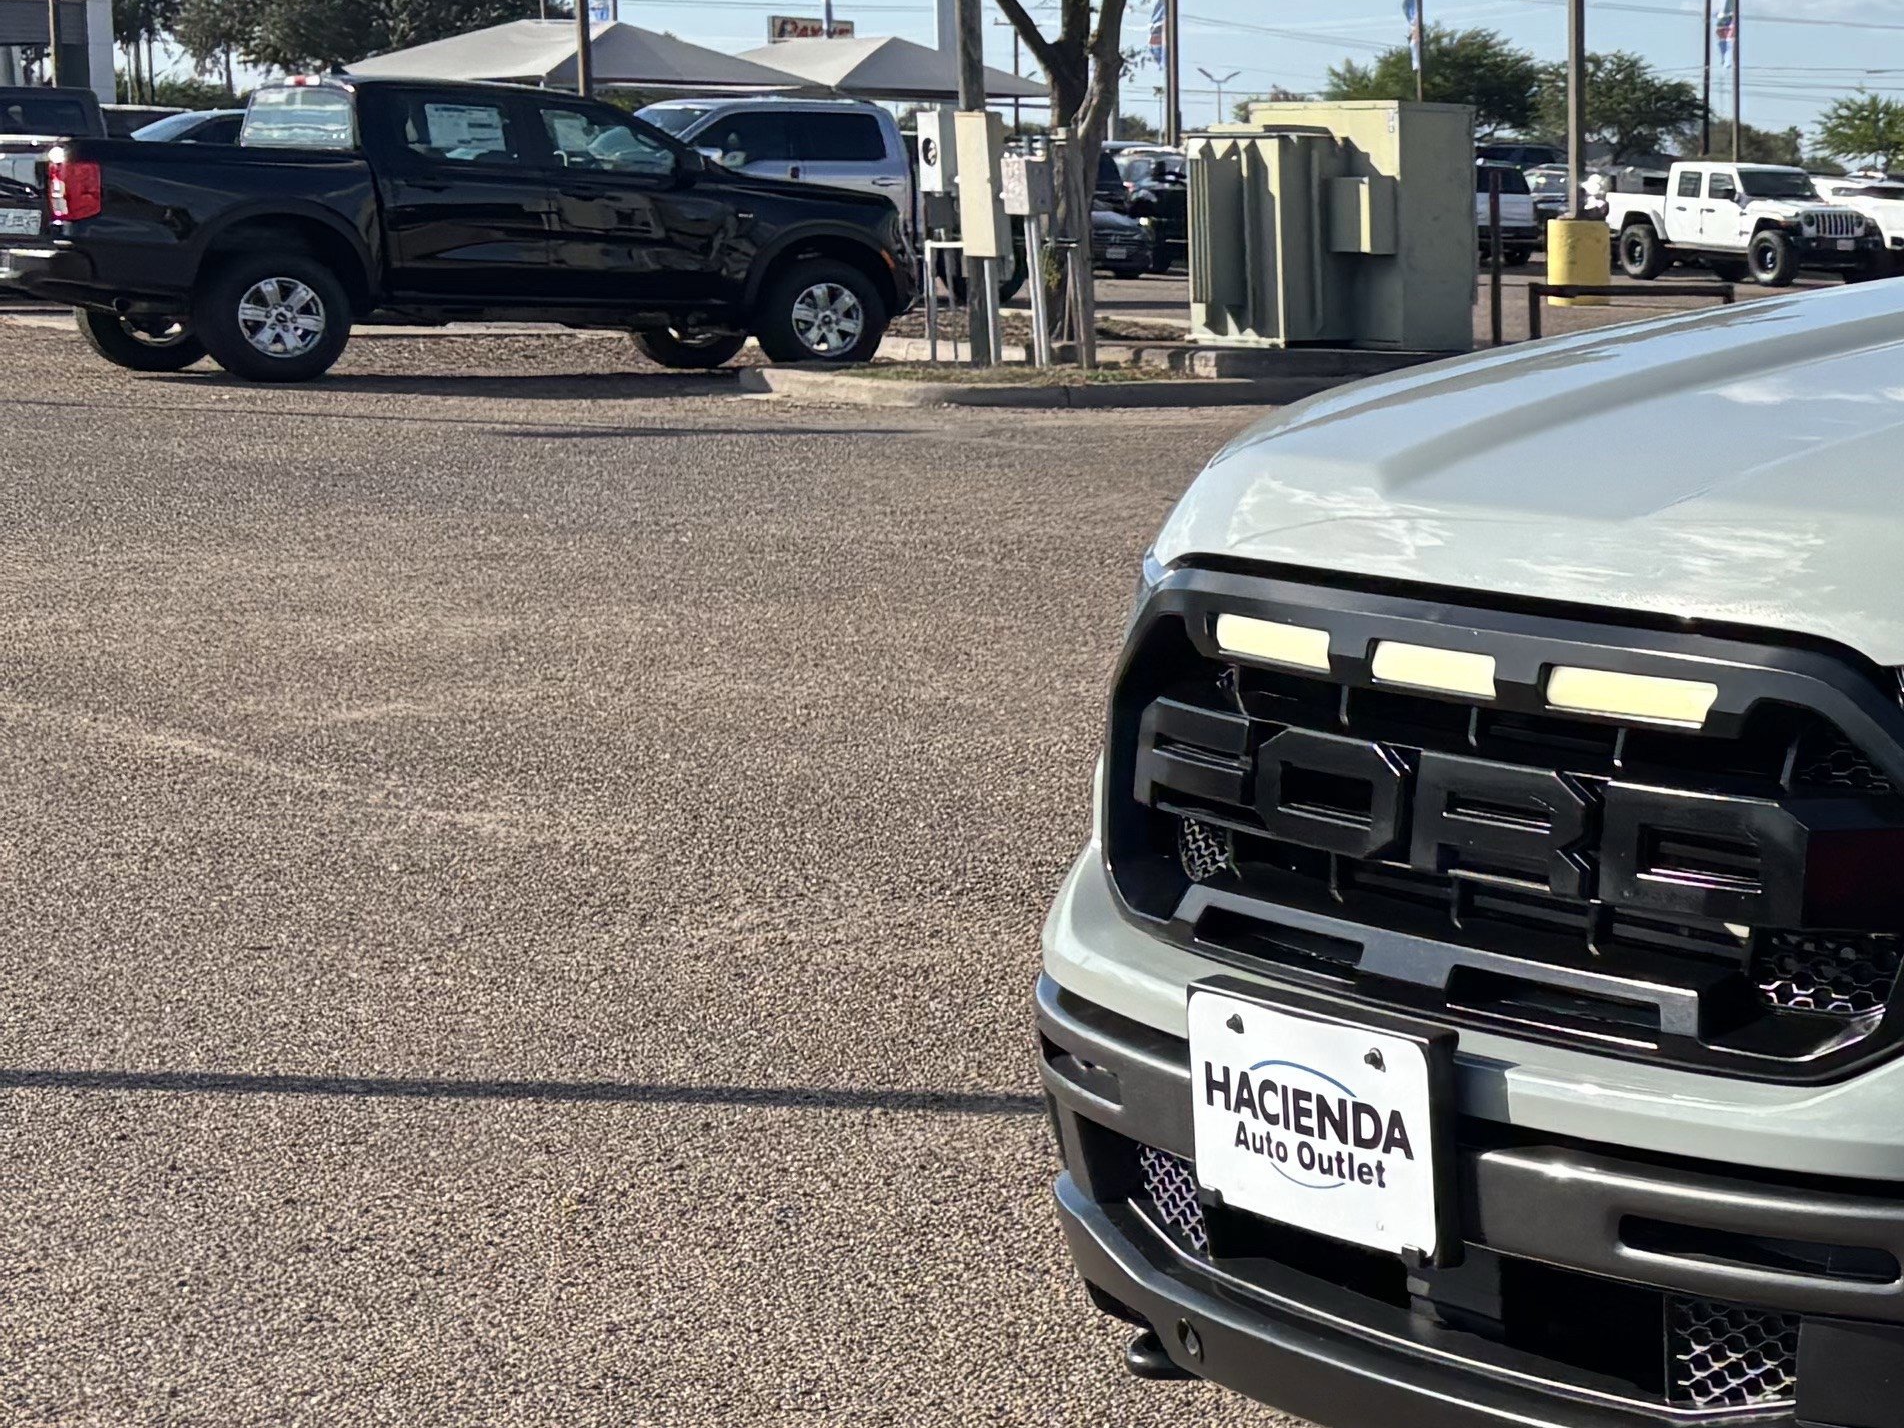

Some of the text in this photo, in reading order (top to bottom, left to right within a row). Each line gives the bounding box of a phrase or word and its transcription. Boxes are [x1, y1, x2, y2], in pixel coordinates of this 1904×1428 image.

[1133, 694, 1808, 934] FORD
[1204, 1060, 1415, 1161] HACIENDA
[1234, 1120, 1387, 1189] Auto Outlet
